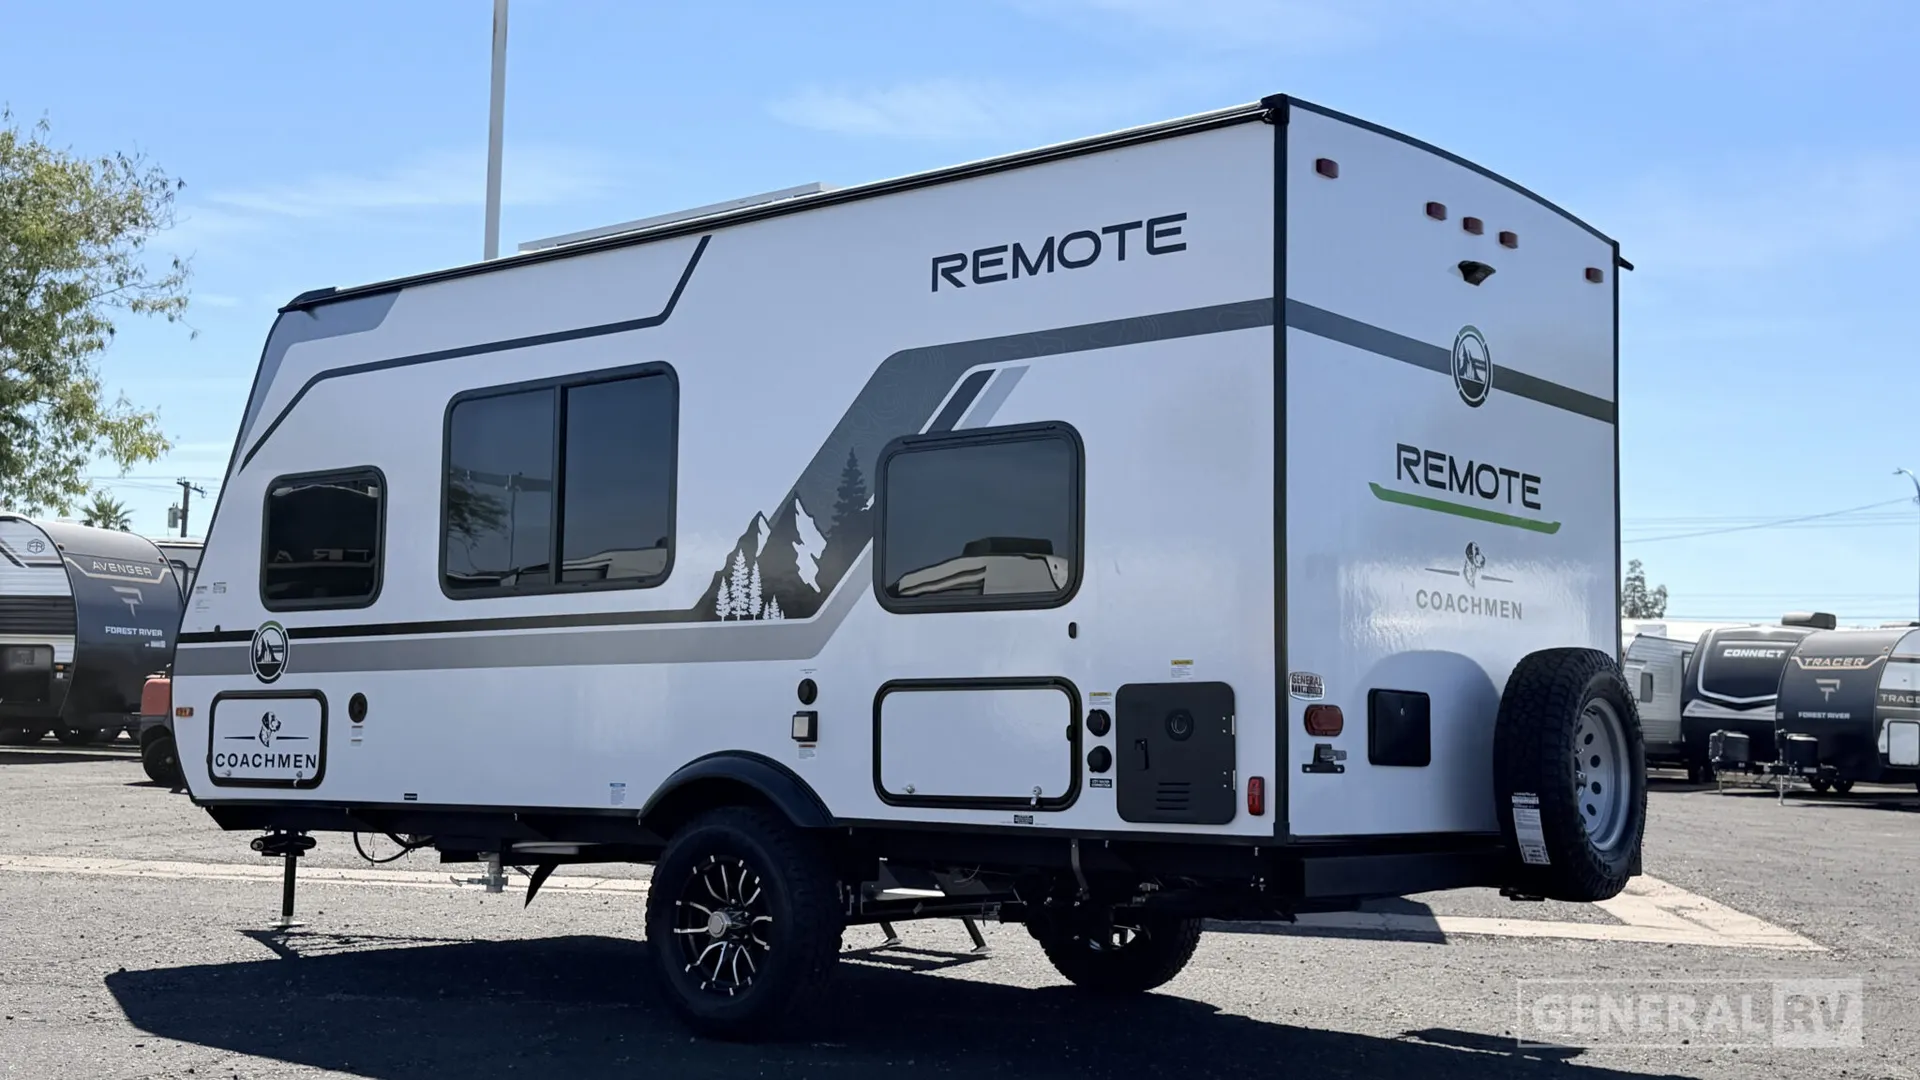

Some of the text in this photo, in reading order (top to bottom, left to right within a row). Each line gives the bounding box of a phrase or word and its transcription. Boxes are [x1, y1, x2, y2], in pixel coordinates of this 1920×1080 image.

[931, 212, 1187, 293] REMOTE
[1396, 443, 1541, 510] REMOTE
[92, 561, 153, 576] AVENGER
[1415, 589, 1523, 620] COACHMEN
[105, 625, 163, 637] FOREST RIVER
[1723, 648, 1786, 658] CONNECT
[1804, 657, 1865, 667] TRACER
[1291, 674, 1323, 687] GENERAL
[215, 753, 317, 769] COACHMEN
